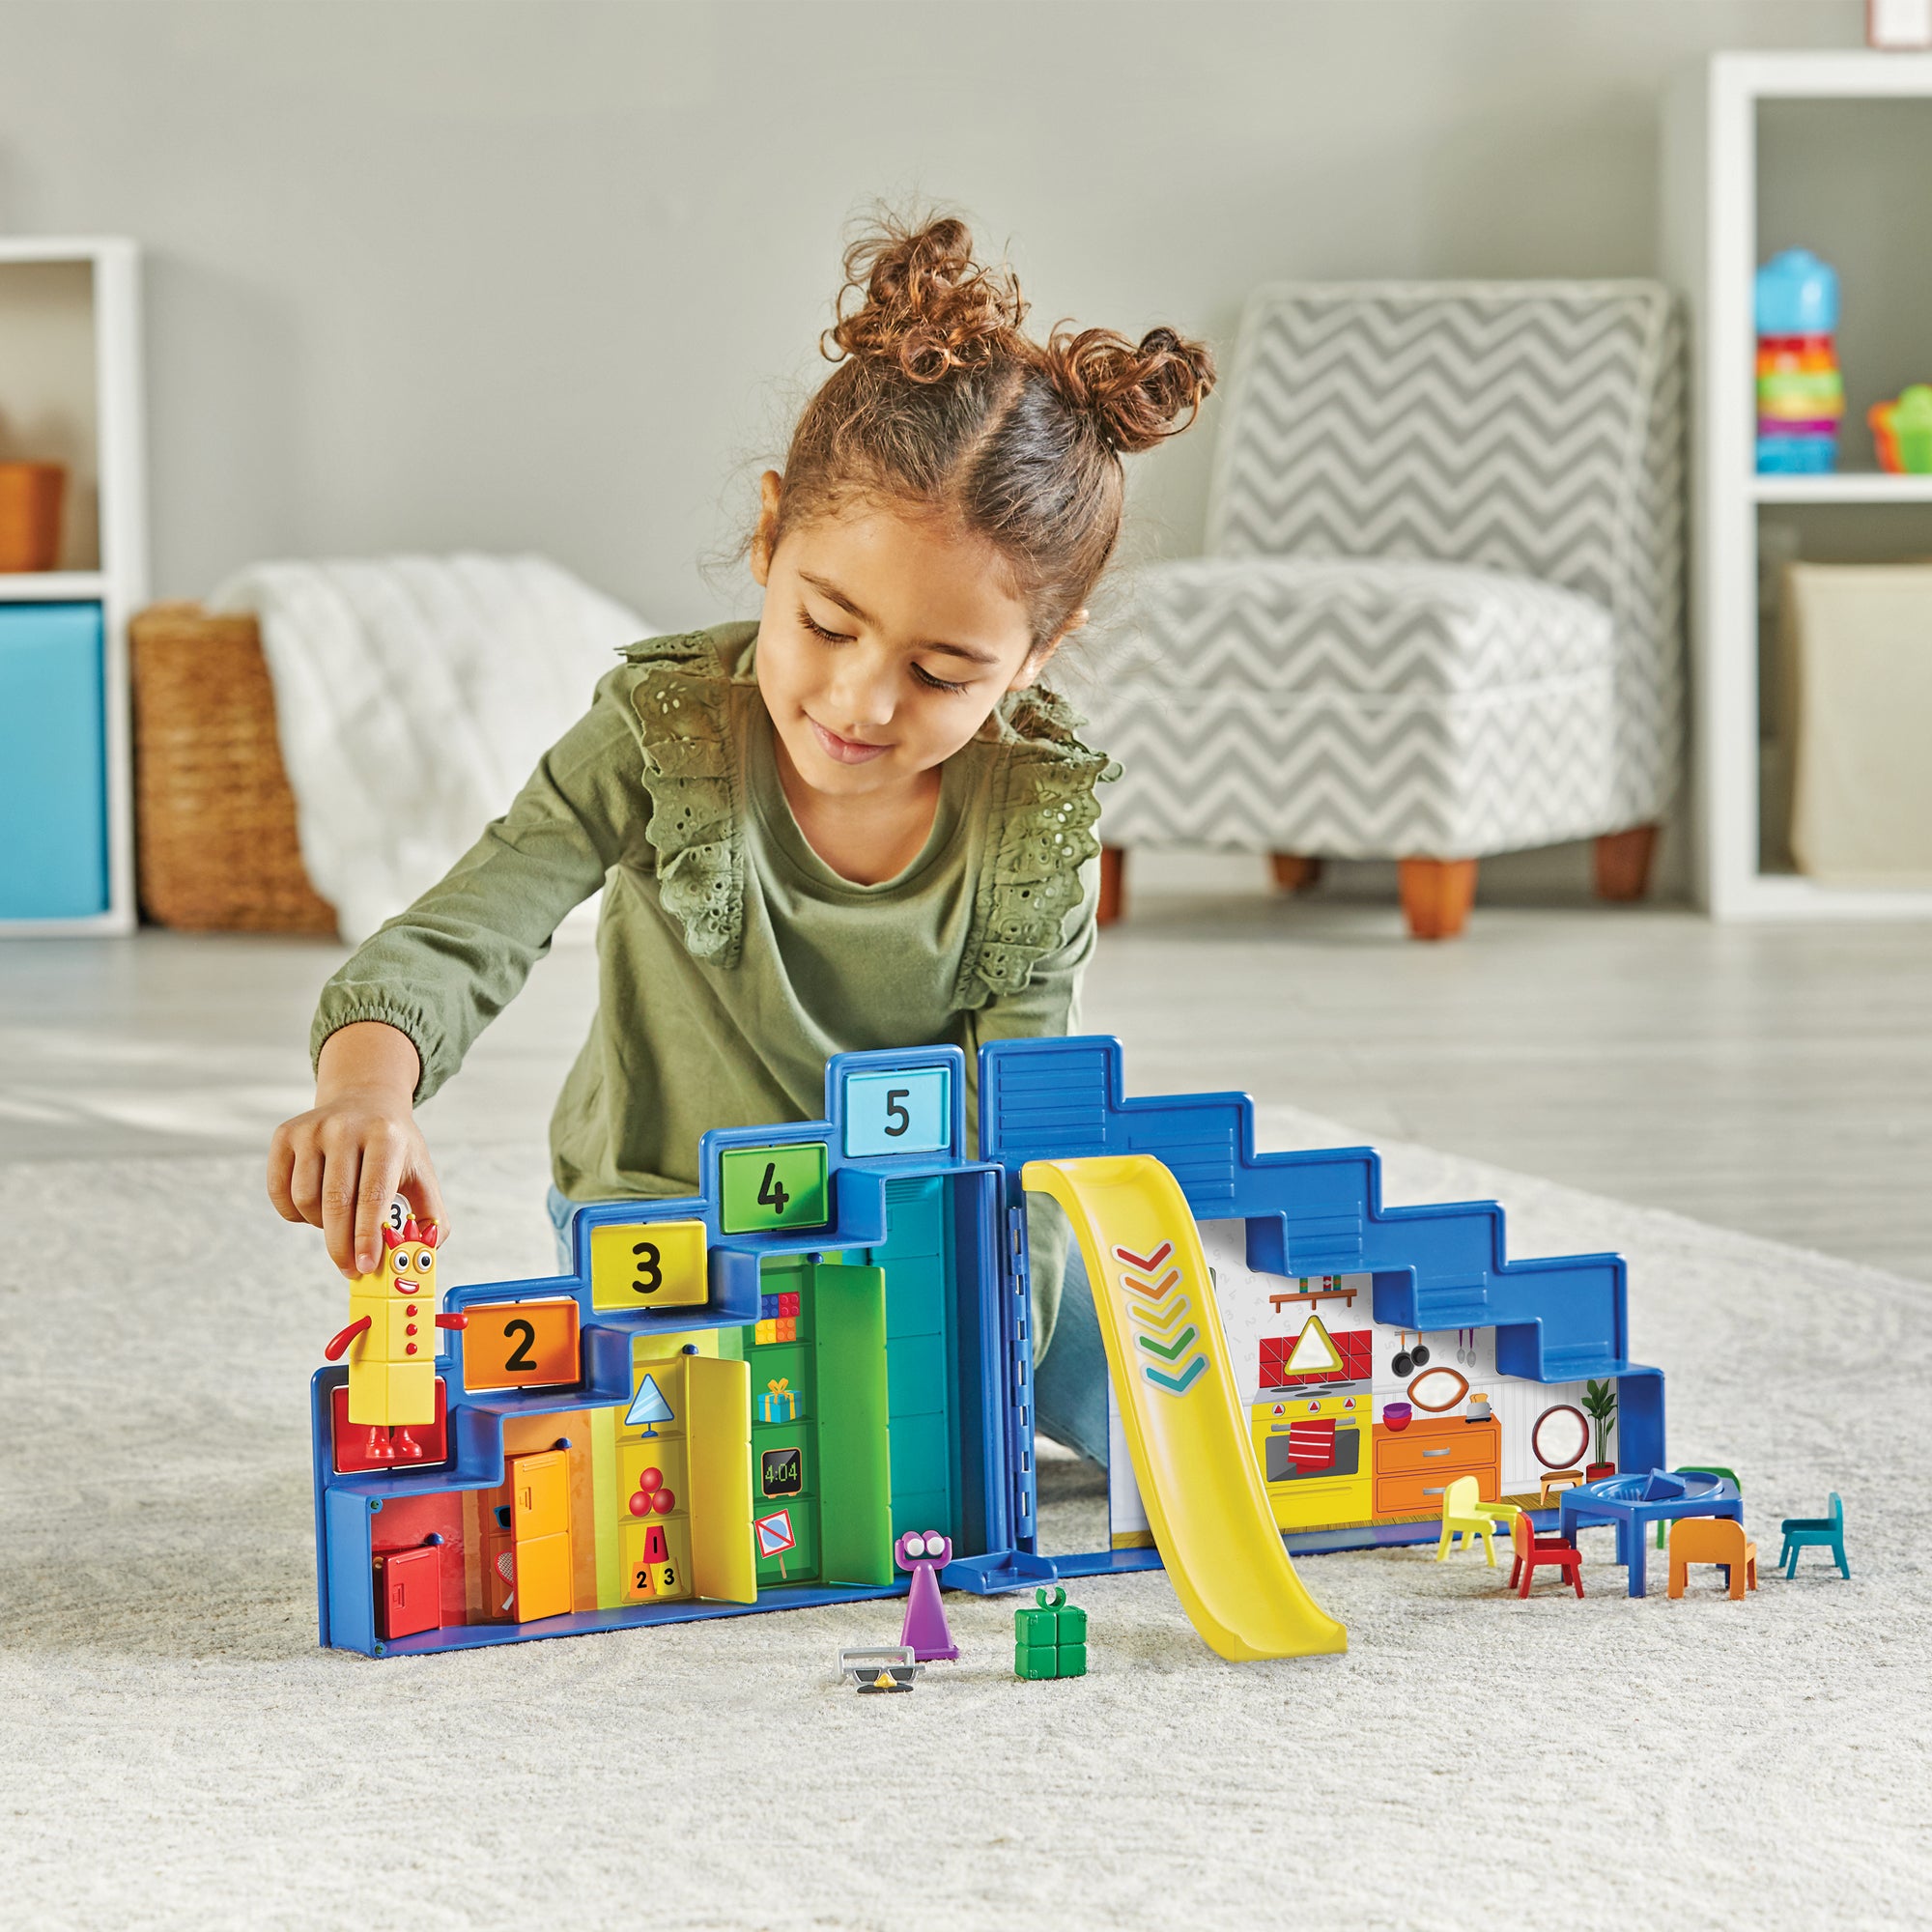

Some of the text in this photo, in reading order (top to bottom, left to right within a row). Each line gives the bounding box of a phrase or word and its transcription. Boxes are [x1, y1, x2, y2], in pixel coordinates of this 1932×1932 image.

[884, 1089, 910, 1137] 5
[757, 1162, 790, 1214] 4
[389, 1204, 402, 1231] 3
[632, 1242, 663, 1294] 3
[503, 1319, 537, 1372] 2
[764, 1462, 799, 1484] 4:04
[652, 1535, 659, 1554] 1
[636, 1570, 648, 1589] 2
[664, 1567, 675, 1586] 3
